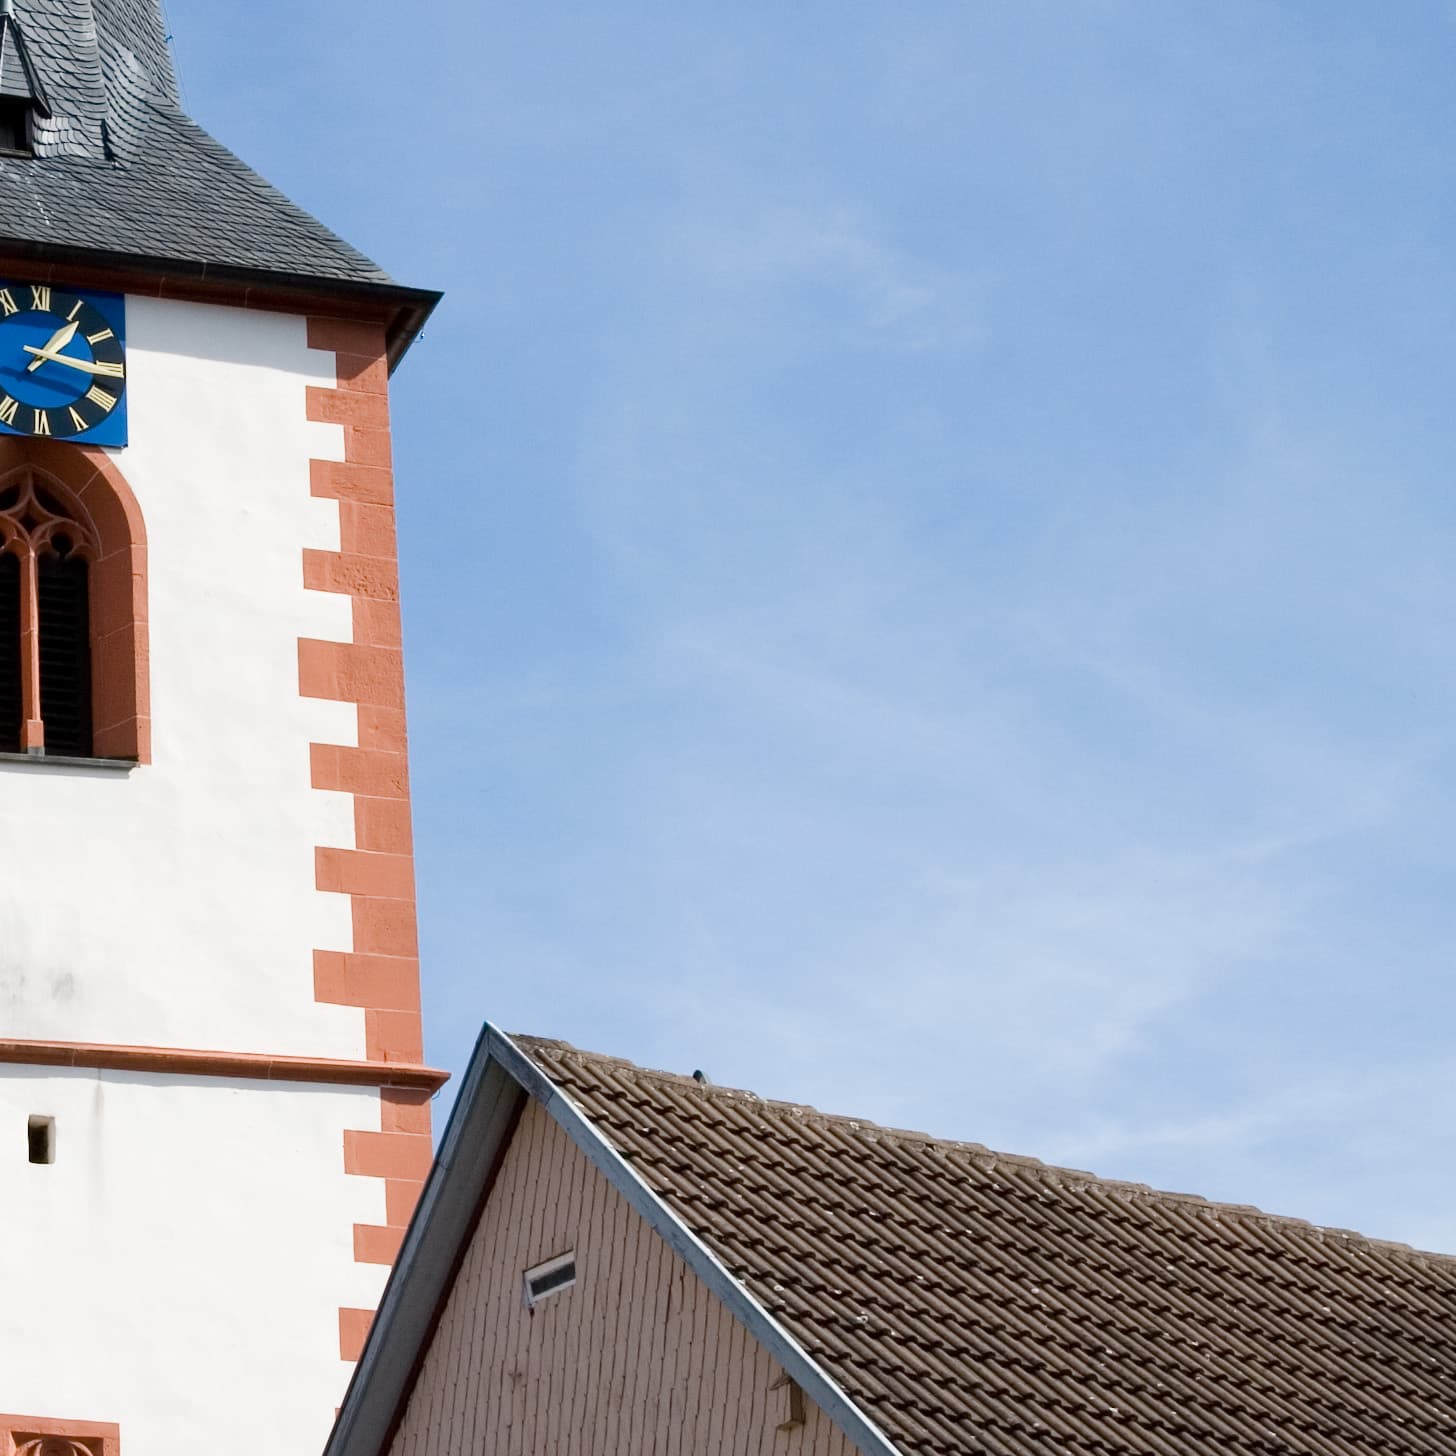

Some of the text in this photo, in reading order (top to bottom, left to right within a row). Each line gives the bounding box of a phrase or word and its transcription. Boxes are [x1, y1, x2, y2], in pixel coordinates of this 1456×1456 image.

[30, 285, 52, 312] XII
[66, 300, 84, 321] I
[87, 328, 114, 345] II
[33, 408, 52, 435] VI
[68, 406, 89, 431] V
